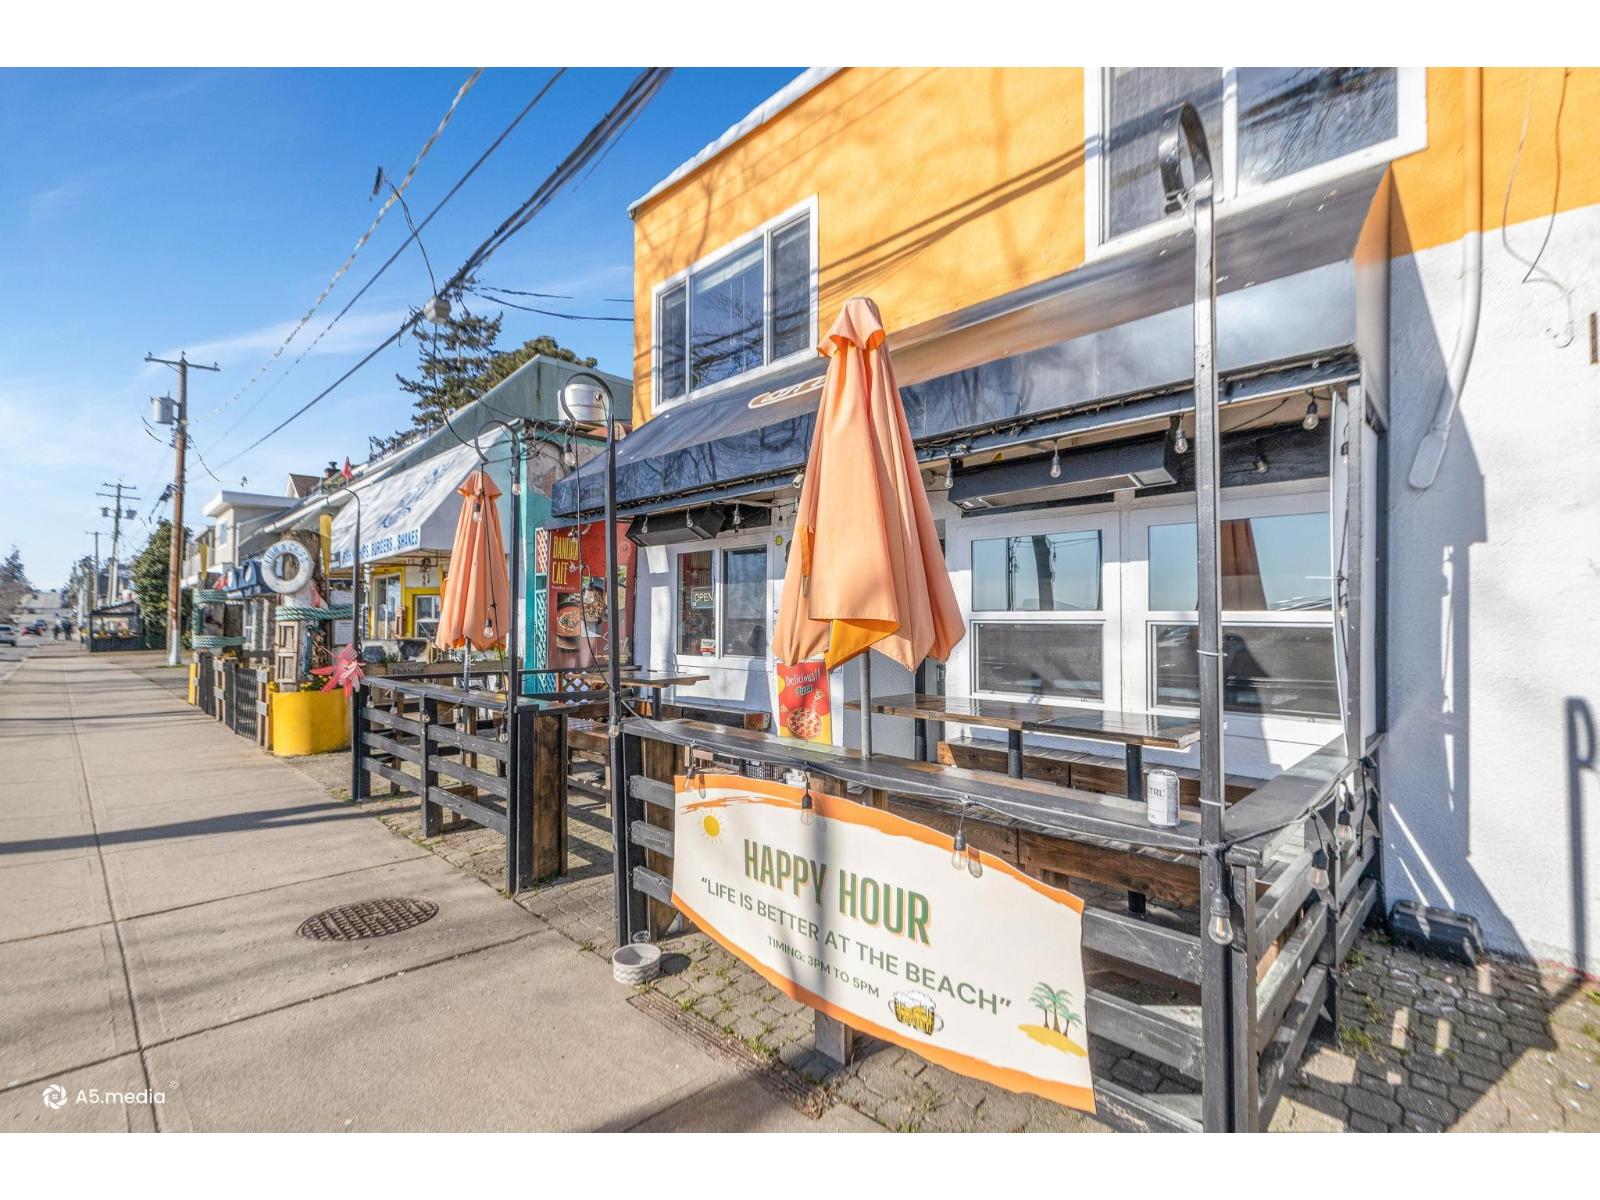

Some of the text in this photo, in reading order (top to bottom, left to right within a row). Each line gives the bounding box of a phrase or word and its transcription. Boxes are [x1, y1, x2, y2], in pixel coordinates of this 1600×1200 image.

[397, 529, 419, 549] SHAKES
[552, 561, 568, 585] CAFE
[694, 592, 714, 603] OPEN
[744, 838, 931, 947] HAPPY HOUR
[740, 892, 753, 911] IS
[757, 900, 819, 942] BETTER
[825, 930, 851, 953] AT
[856, 941, 900, 976] THE
[767, 935, 880, 999] TIMING: 3PM TO 5PM
